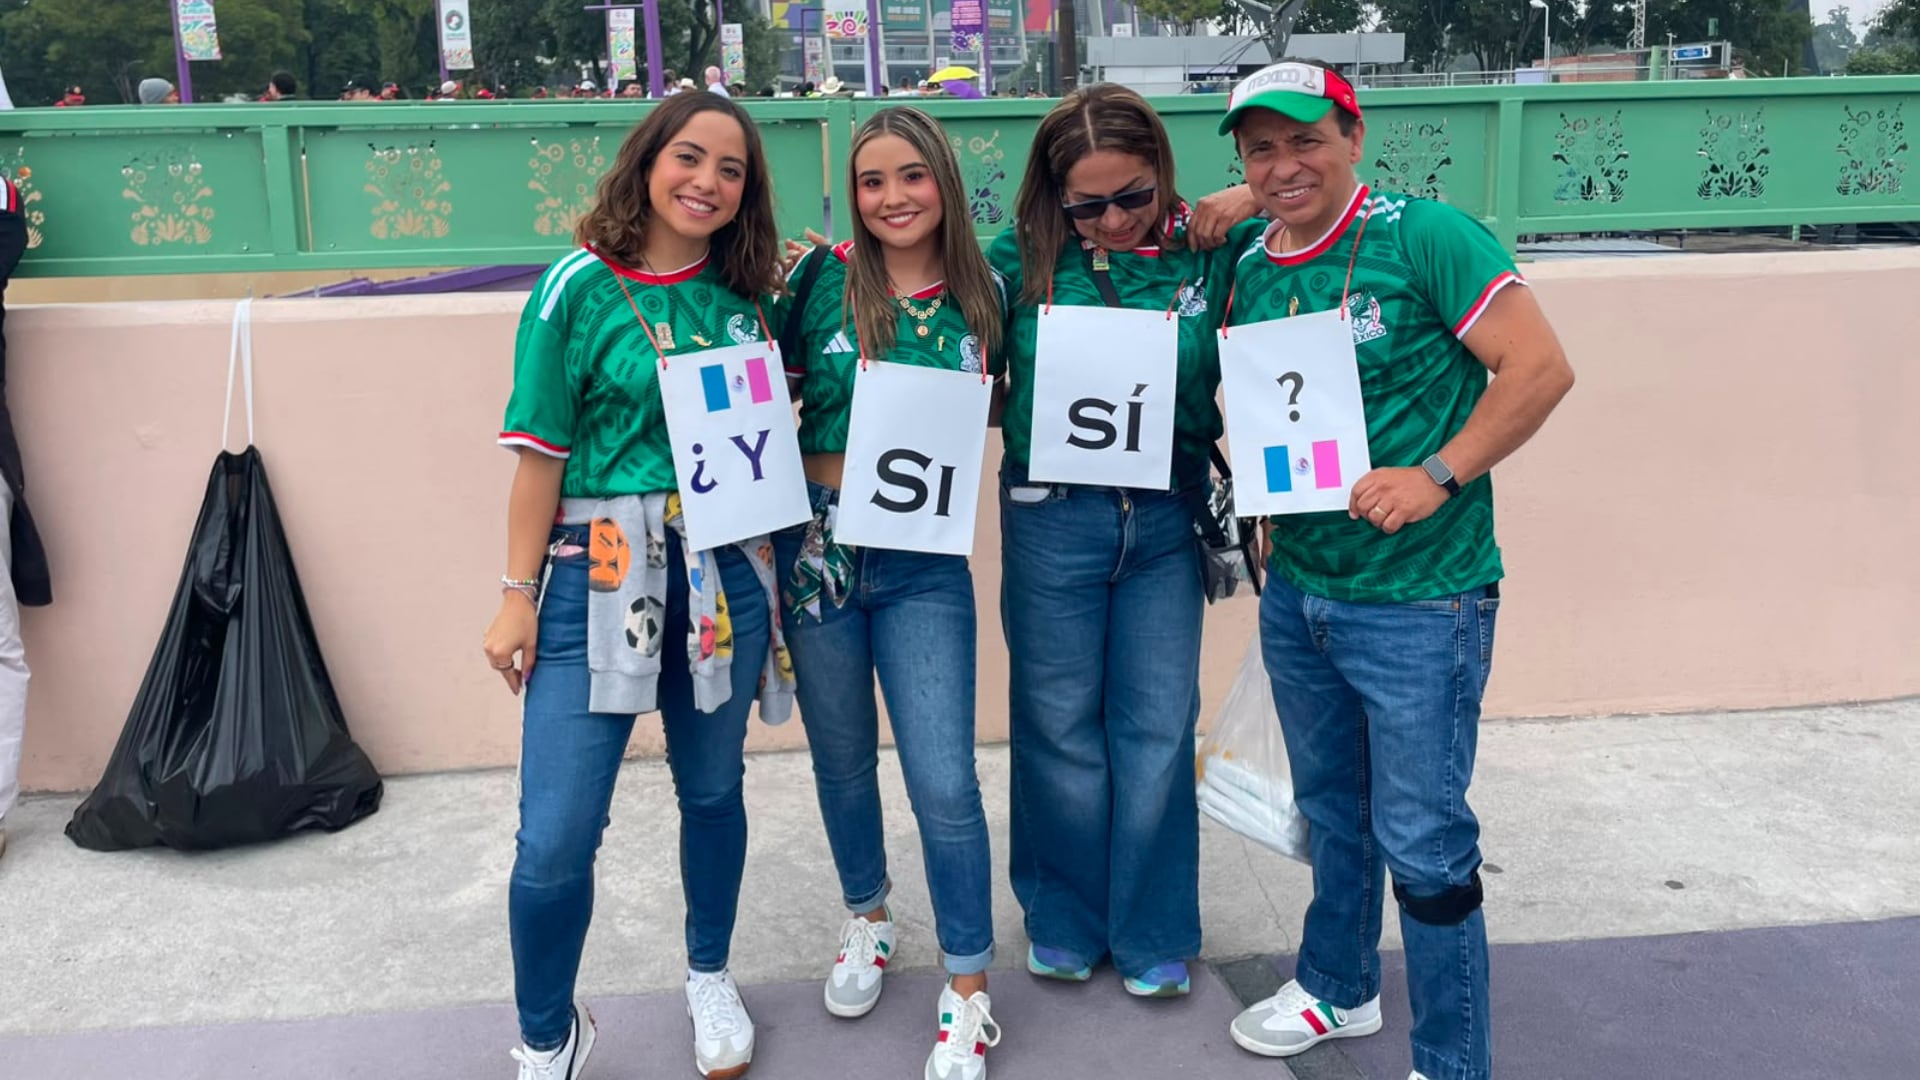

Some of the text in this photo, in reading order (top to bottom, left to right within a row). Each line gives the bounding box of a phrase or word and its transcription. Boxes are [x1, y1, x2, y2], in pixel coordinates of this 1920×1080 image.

[1065, 383, 1149, 453] SÍ
[1276, 371, 1304, 422] ?
[729, 429, 771, 481] Y
